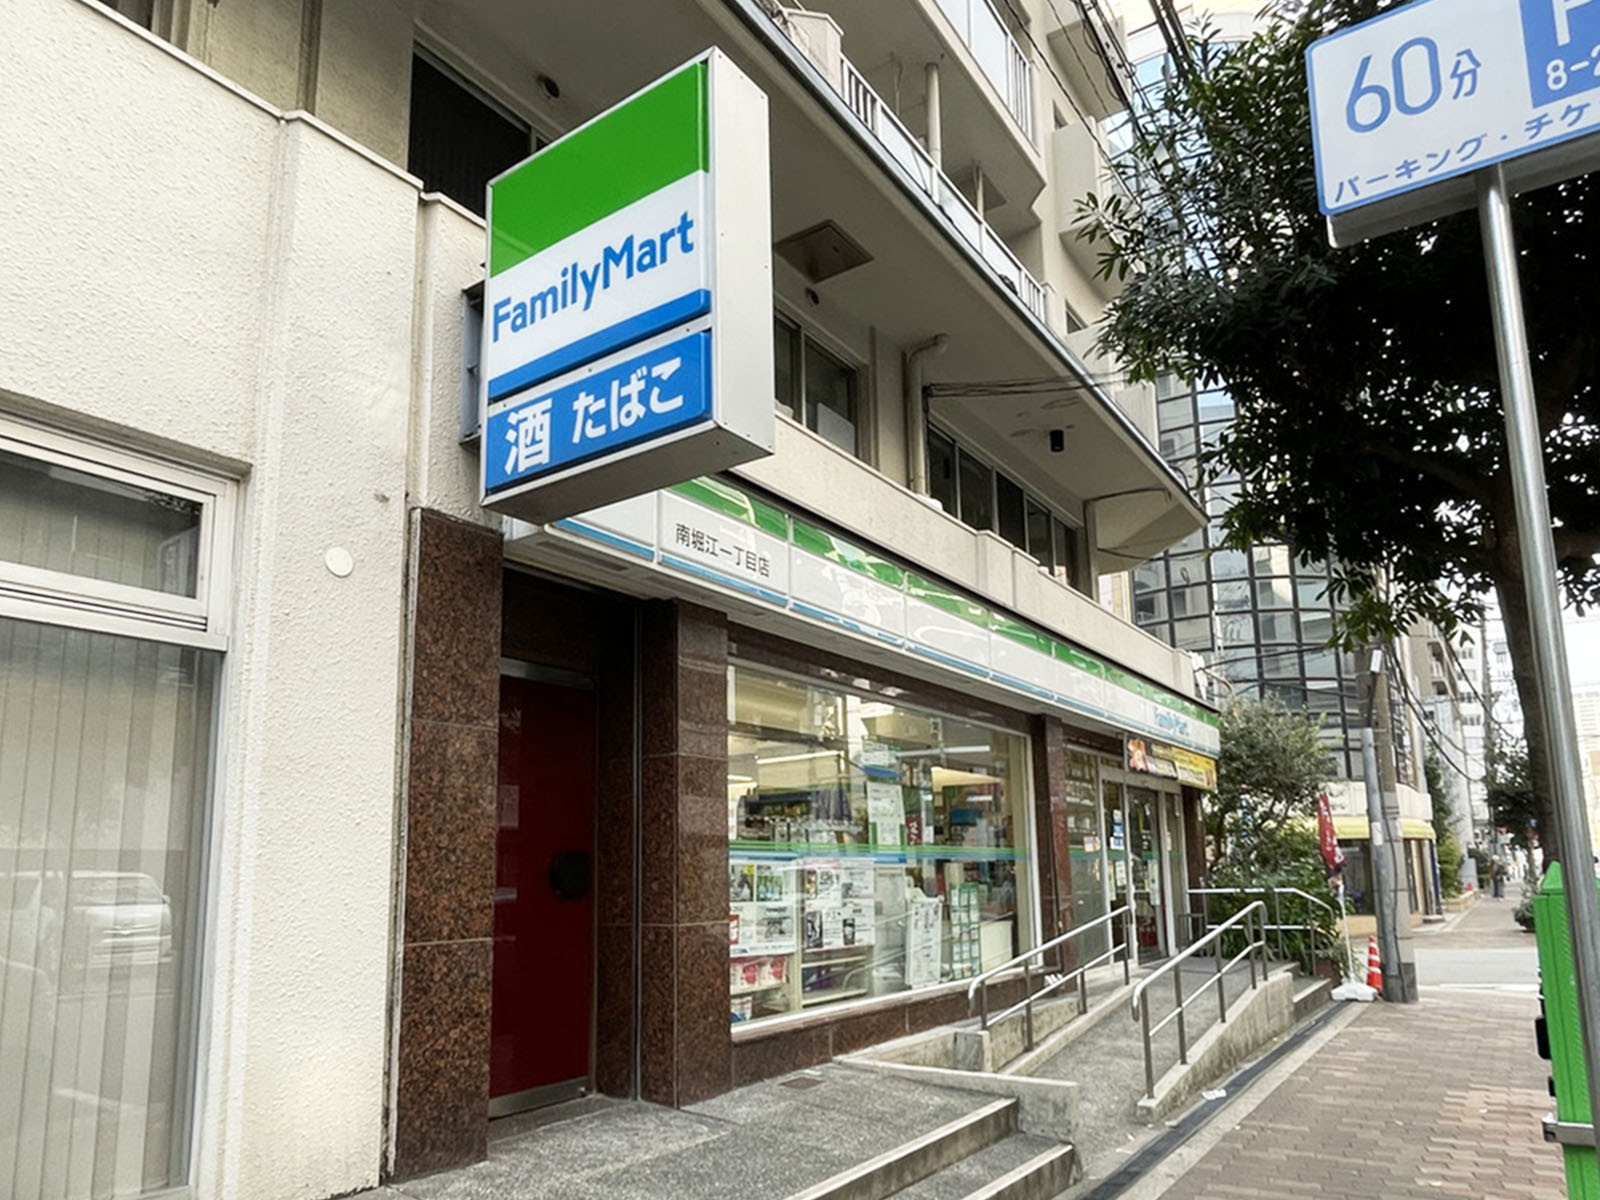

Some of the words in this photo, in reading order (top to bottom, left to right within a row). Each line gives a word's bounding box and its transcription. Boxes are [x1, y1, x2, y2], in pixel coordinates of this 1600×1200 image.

[1346, 37, 1481, 133] 60分
[493, 211, 695, 342] FamilyMart
[505, 398, 552, 475] 酒
[572, 357, 684, 443] たばこ
[676, 522, 770, 578] 南堀江一丁目店
